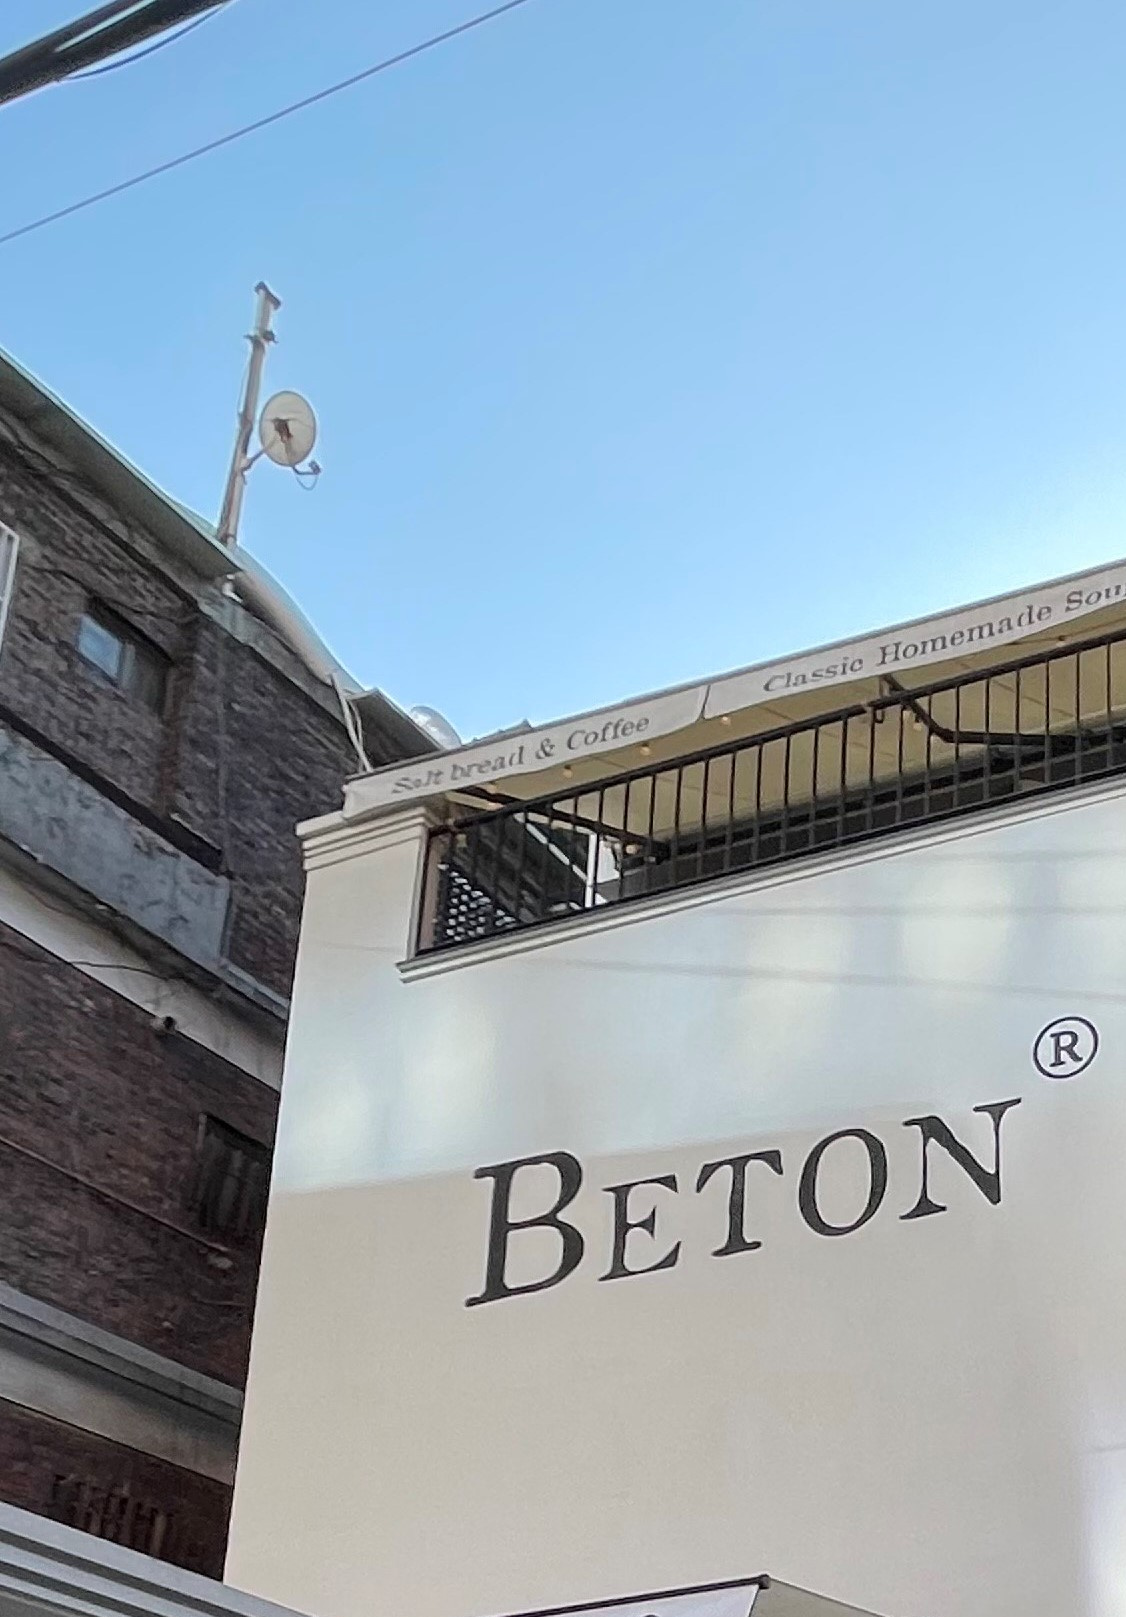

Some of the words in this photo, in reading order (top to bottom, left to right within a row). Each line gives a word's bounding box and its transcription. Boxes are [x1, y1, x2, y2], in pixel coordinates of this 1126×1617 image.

[762, 655, 865, 693] Classic
[875, 604, 1052, 666] Homemade
[391, 768, 444, 794] Salt
[450, 745, 524, 780] bread
[535, 737, 556, 760] &
[566, 715, 651, 751] Coffee
[464, 1096, 1022, 1309] BETON
